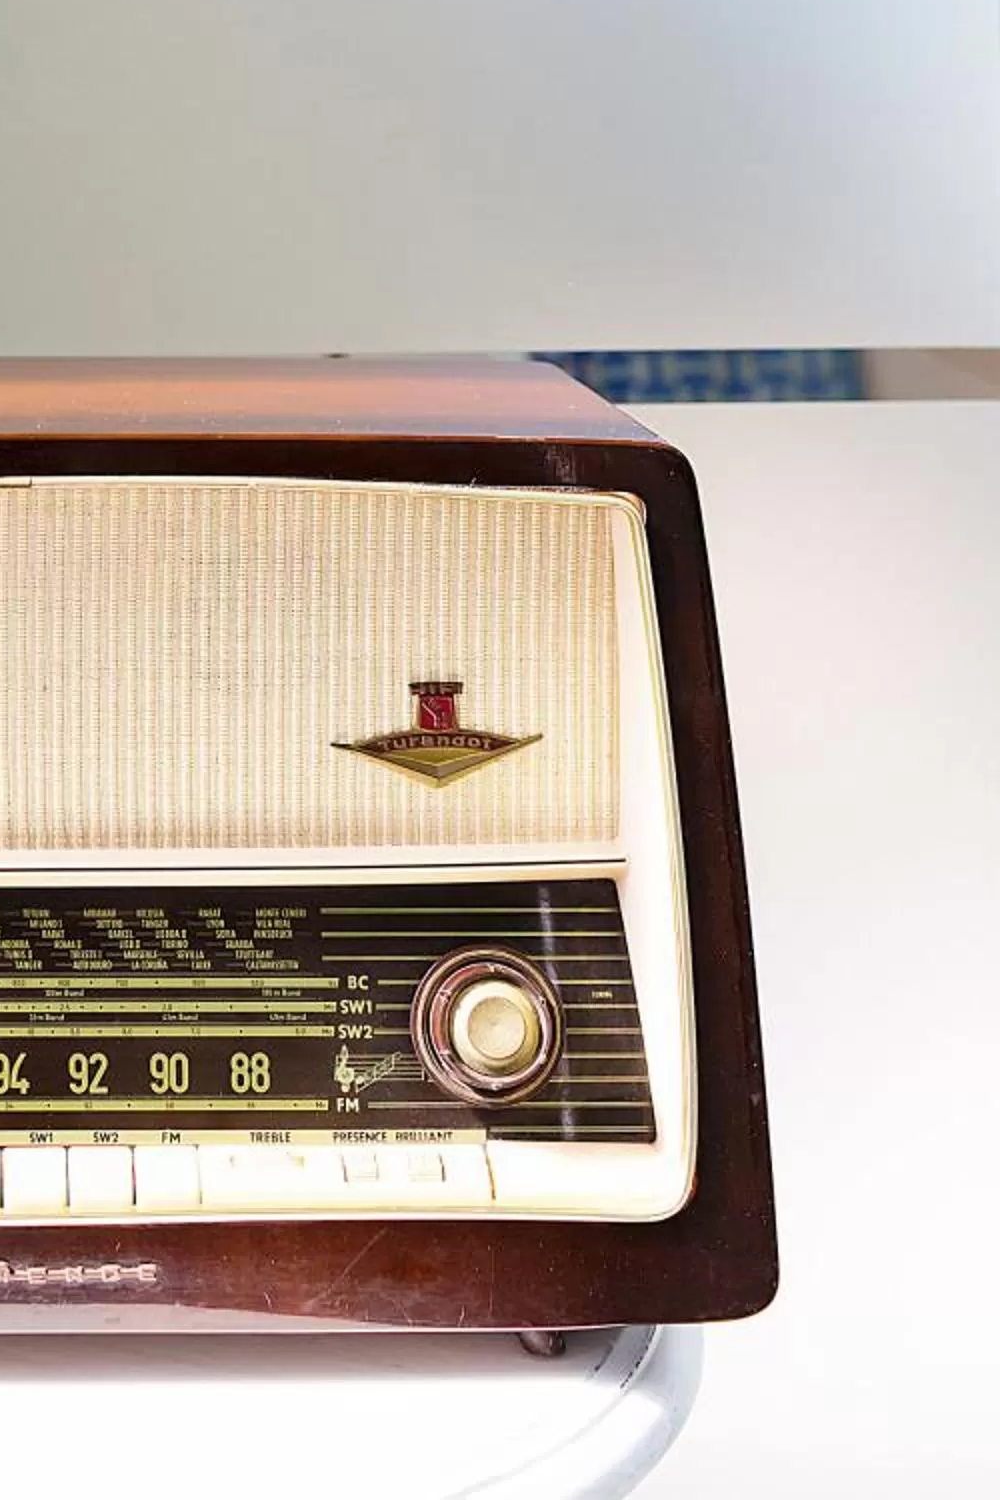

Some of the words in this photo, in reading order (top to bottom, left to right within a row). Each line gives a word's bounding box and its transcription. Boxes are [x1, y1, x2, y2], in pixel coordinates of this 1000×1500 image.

[347, 975, 369, 990] BC
[339, 1000, 373, 1014] SW1
[338, 1024, 373, 1039] SW2
[68, 1052, 109, 1095] 92
[149, 1052, 189, 1094] 90
[231, 1051, 271, 1094] 88
[336, 1098, 359, 1112] FM
[29, 1132, 53, 1143] SW1
[93, 1132, 119, 1143] SW2
[161, 1132, 181, 1144] FM
[250, 1132, 291, 1143] TREBLE
[333, 1132, 387, 1143] PRESENCE
